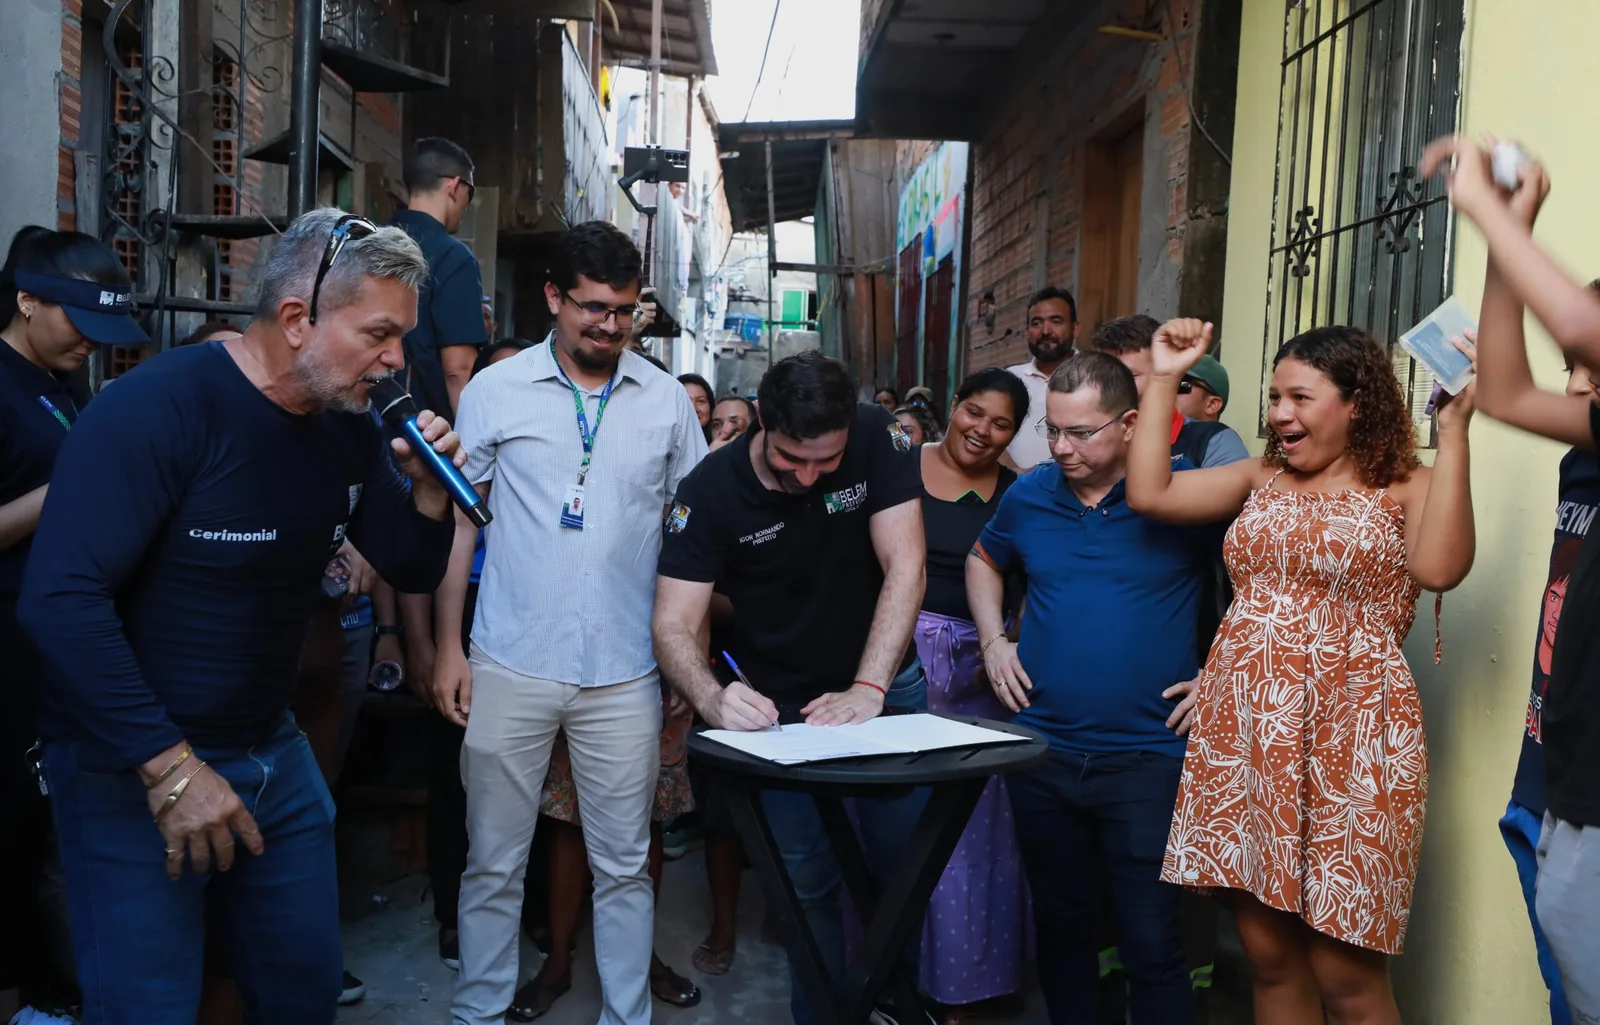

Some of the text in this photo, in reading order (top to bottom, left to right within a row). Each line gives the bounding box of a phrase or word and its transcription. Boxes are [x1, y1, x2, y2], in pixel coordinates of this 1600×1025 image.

[116, 293, 131, 302] BELE
[189, 528, 277, 542] Cerimonial
[739, 521, 785, 544] IGOR NORMANDO
